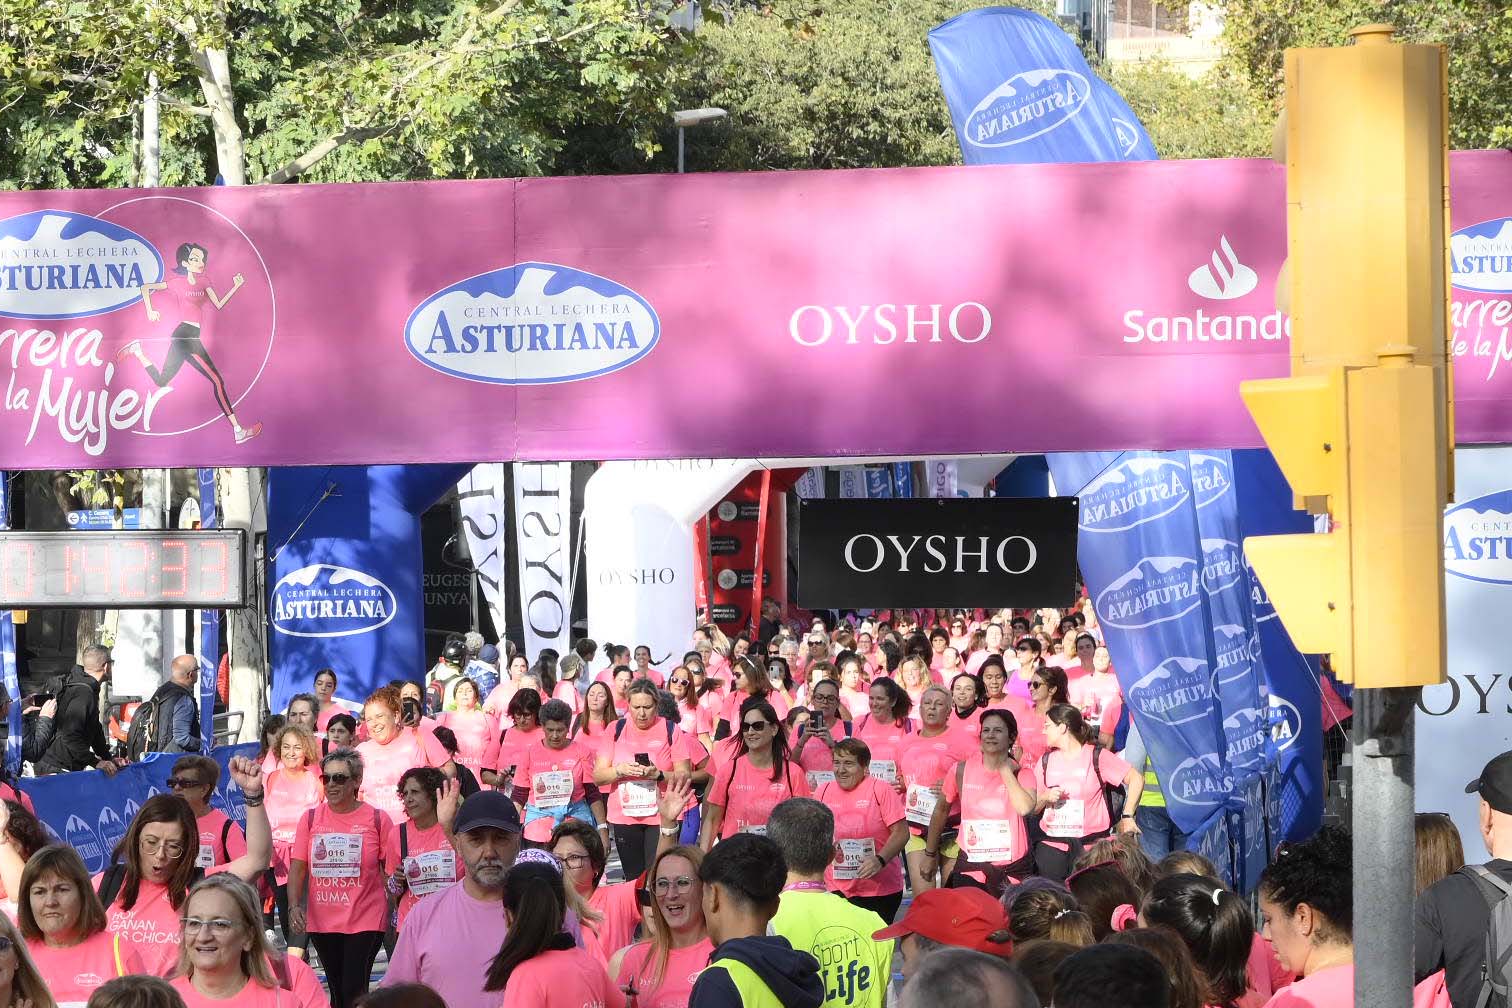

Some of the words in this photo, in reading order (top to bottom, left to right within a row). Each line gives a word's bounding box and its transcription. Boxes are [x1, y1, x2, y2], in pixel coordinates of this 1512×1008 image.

[67, 246, 139, 257] LECHERA
[464, 306, 541, 318] CENTRAL
[551, 304, 632, 316] LECHERA
[789, 301, 992, 346] OYSHO
[1123, 308, 1292, 343] Santand
[424, 310, 640, 354] ASTURIANA
[5, 372, 30, 411] la
[25, 362, 174, 456] Mujer
[1471, 521, 1511, 530] CENT
[844, 534, 1038, 575] OYSHO
[600, 567, 675, 586] OYSHO
[287, 588, 326, 598] CENTRAL
[331, 588, 382, 598] LECHERA
[275, 593, 387, 622] ASTURIANA
[316, 877, 362, 888] DORSAL
[316, 890, 350, 902] SUMA
[112, 911, 137, 920] HOY
[110, 920, 156, 931] GANAN
[132, 931, 181, 944] CHICAS
[822, 960, 870, 1005] Life
